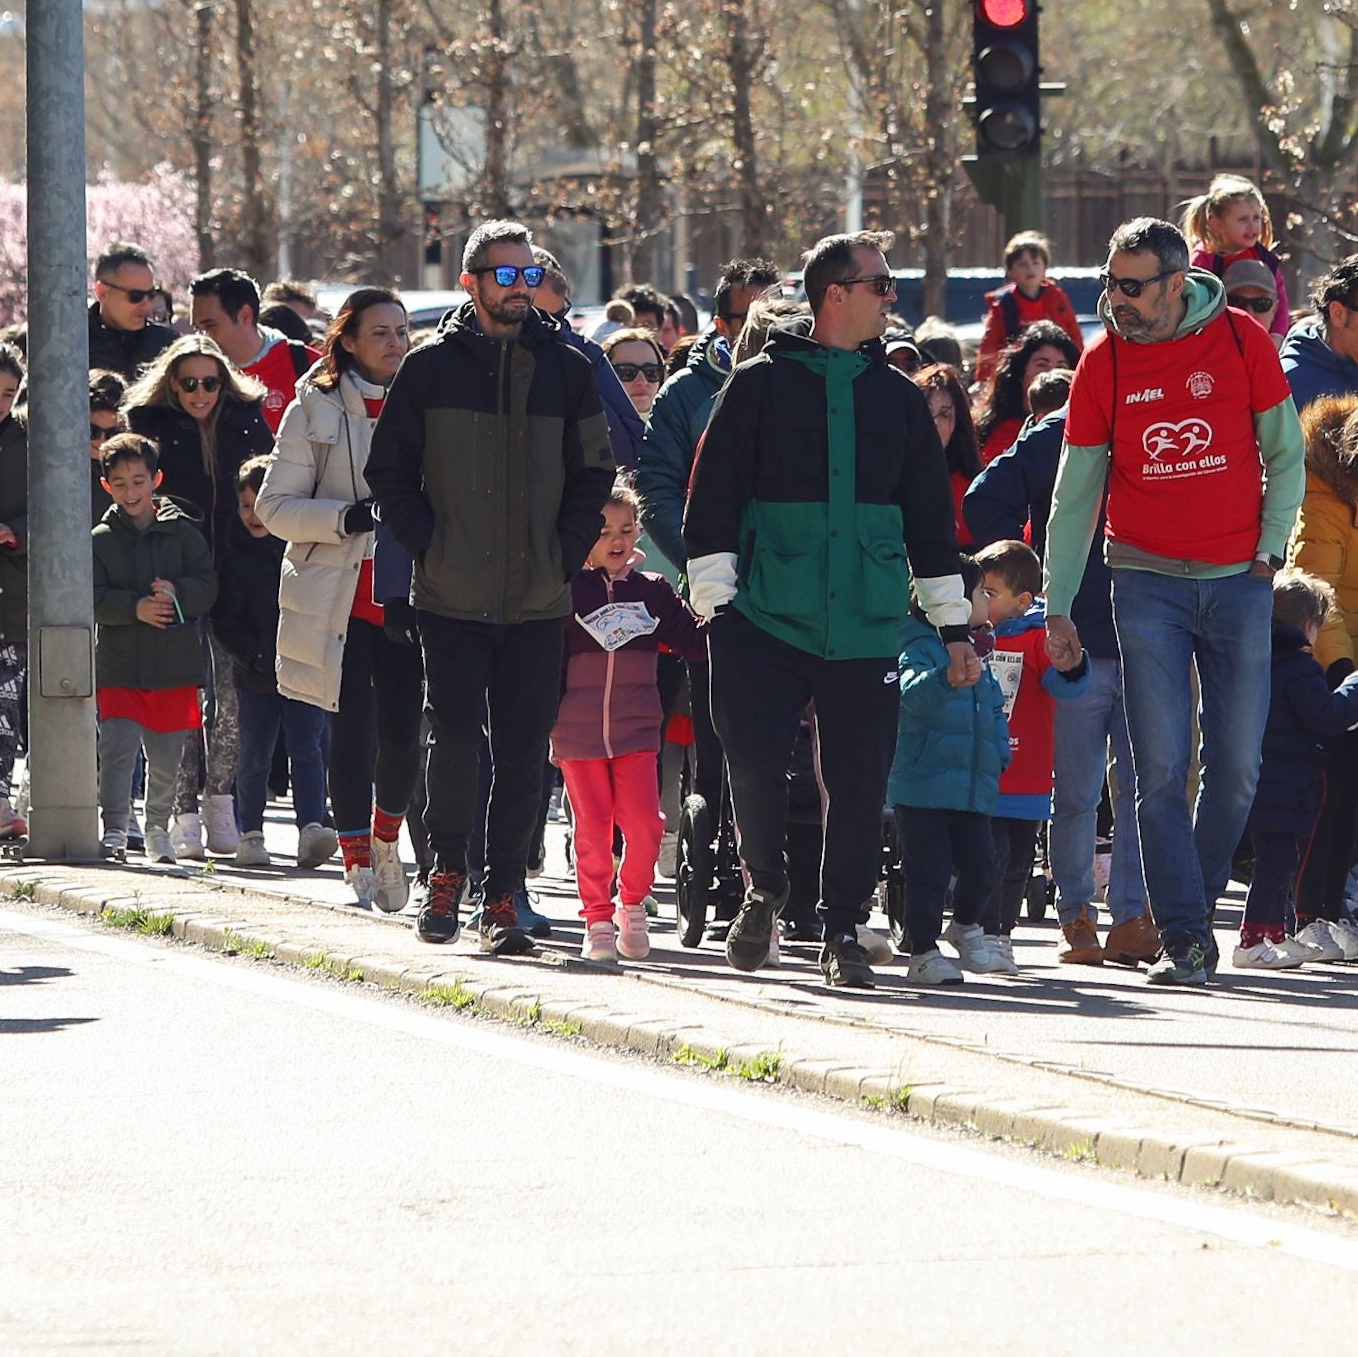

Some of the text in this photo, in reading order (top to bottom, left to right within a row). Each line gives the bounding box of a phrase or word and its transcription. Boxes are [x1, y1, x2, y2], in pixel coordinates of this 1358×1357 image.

[1125, 388, 1164, 404] INAEL
[1142, 454, 1227, 474] Brilla con ellos
